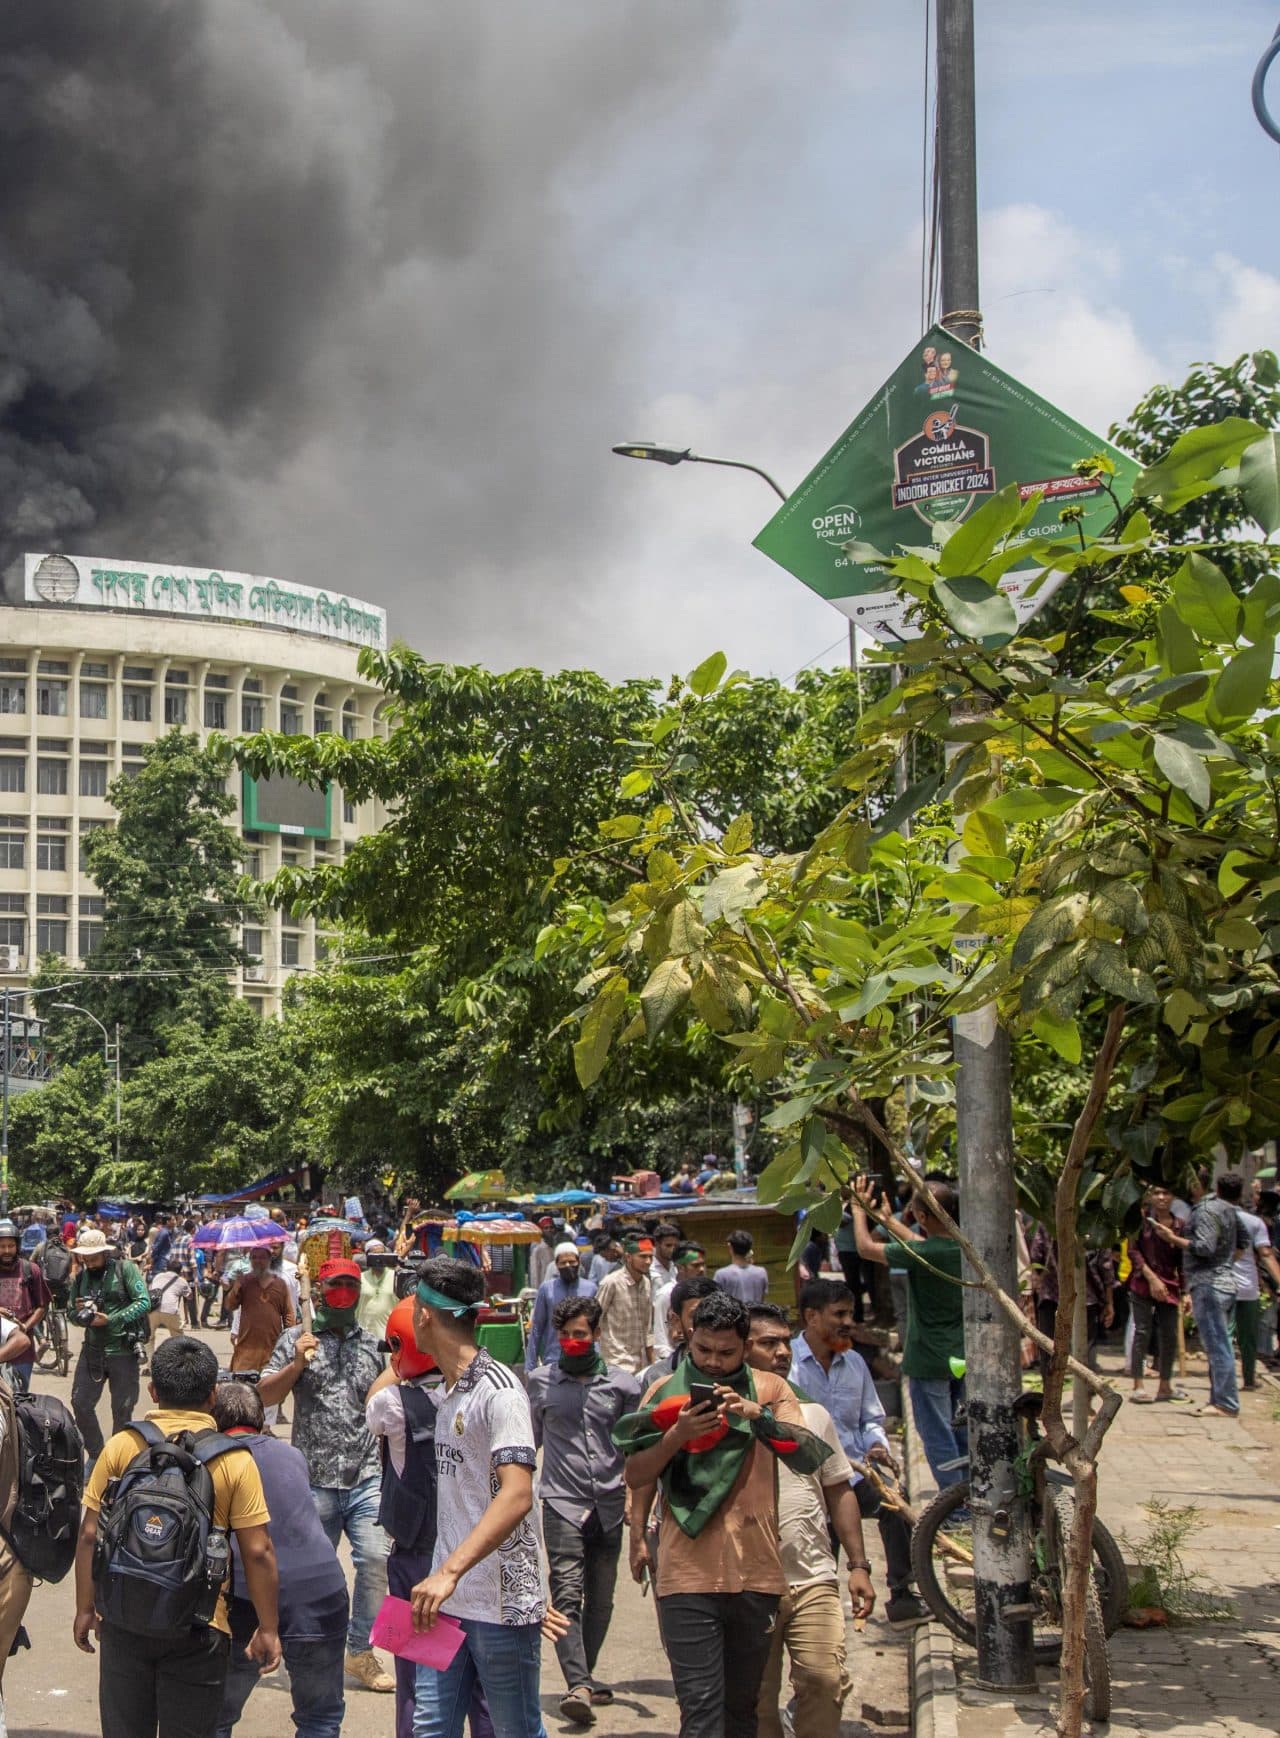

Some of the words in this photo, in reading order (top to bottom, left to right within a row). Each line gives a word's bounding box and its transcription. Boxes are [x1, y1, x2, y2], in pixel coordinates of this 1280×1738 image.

[921, 440, 967, 456] COMILLA
[913, 450, 976, 467] VICTORIANS
[940, 468, 974, 480] UNIVERSITY
[897, 484, 929, 502] INDOOR
[930, 476, 965, 496] CRICKET
[967, 473, 989, 490] 2024
[811, 512, 855, 530] OPEN
[816, 529, 835, 539] FOR
[836, 527, 852, 536] ALL
[1027, 523, 1064, 539] GLORY
[834, 559, 849, 568] 64
[91, 569, 148, 607] বঙ্গবন্ধু
[152, 574, 191, 601] শেখ
[194, 571, 243, 609] মুজিব
